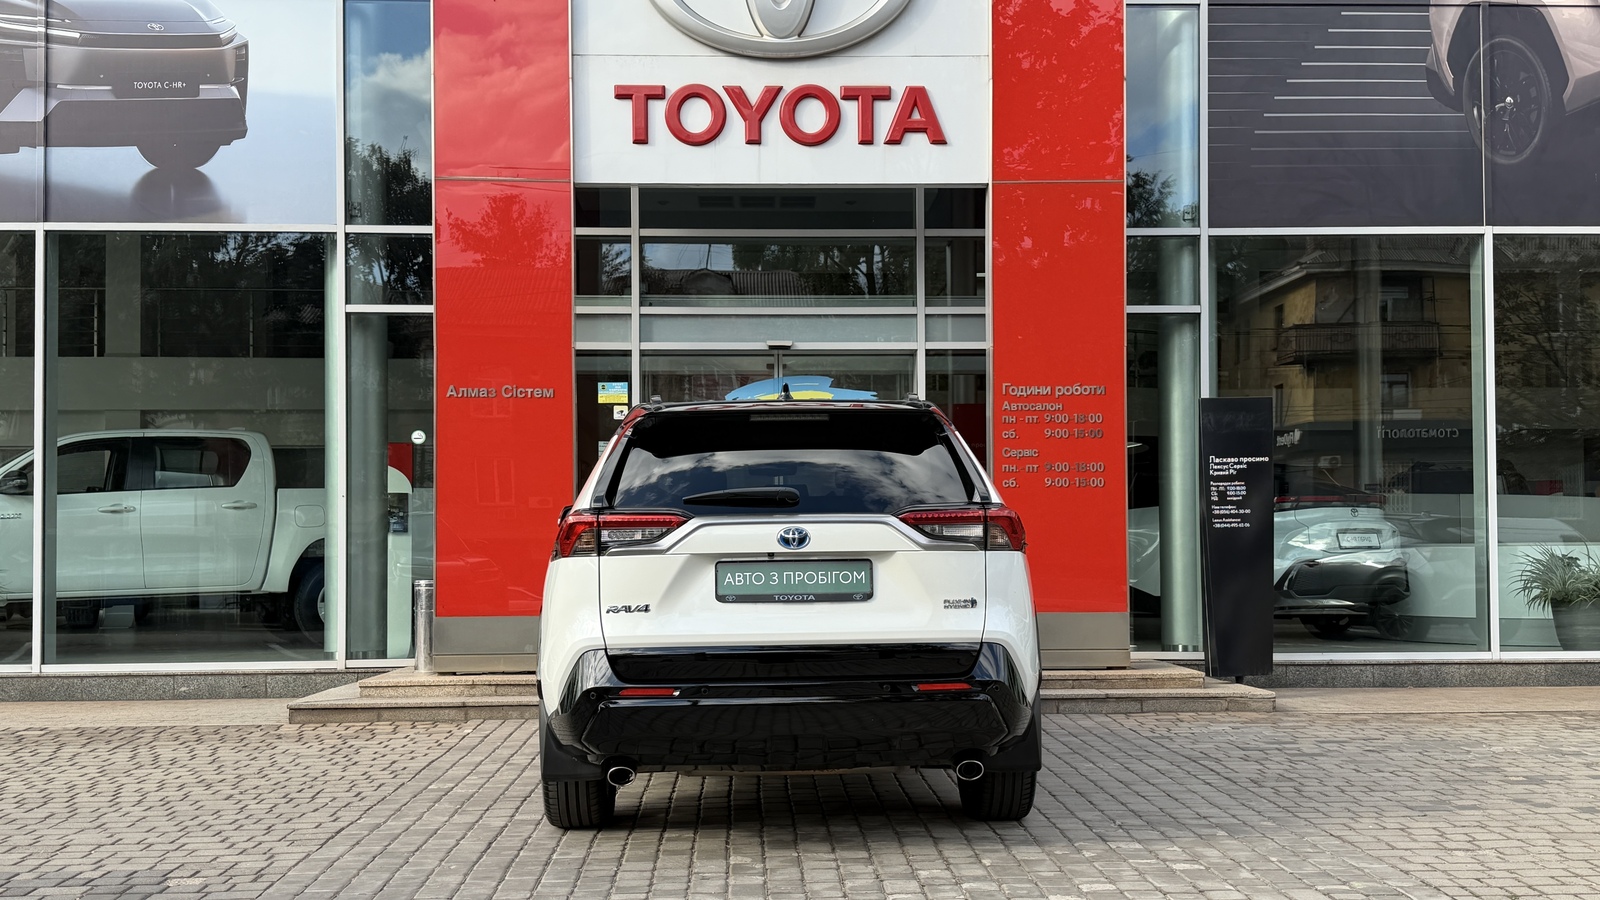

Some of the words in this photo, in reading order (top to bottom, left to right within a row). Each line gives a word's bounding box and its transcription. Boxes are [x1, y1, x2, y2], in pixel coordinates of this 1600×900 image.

[133, 81, 162, 89] TOYOTA
[163, 81, 187, 89] C-HR+
[613, 83, 948, 147] TOYOTA
[446, 384, 497, 399] Алмаз
[501, 384, 555, 399] Сістем
[1002, 383, 1052, 398] Години
[1055, 383, 1106, 399] роботи
[1002, 401, 1063, 412] Автосалон
[1002, 428, 1020, 439] сб.
[1002, 477, 1020, 488] сб.
[724, 572, 765, 586] АВТО
[769, 572, 779, 585] З
[783, 571, 866, 584] ПРОБІГОМ
[605, 604, 651, 614] RAV4
